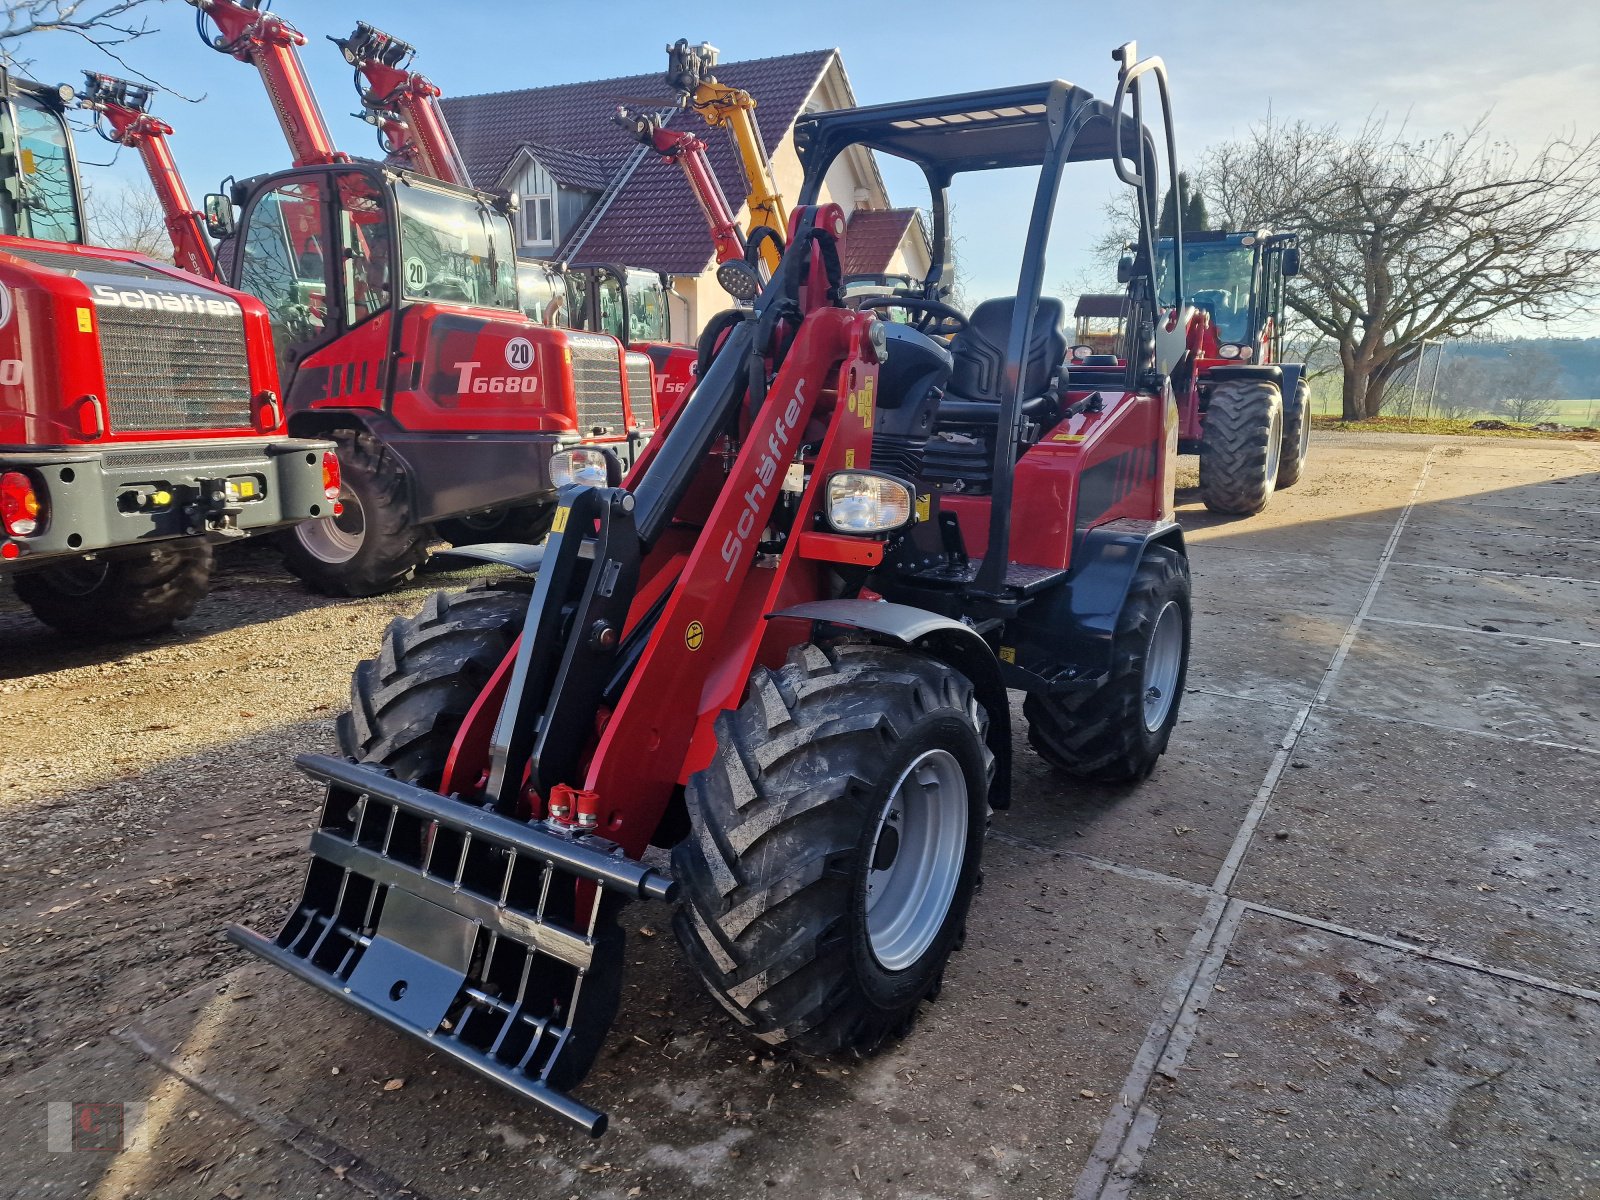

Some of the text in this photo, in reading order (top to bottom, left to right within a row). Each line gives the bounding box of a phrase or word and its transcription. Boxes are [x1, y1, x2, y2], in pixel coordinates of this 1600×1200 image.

[410, 262, 423, 284] 20
[93, 284, 243, 316] Schäffer
[511, 343, 529, 364] 20
[453, 361, 538, 394] T6680
[655, 373, 688, 393] T56
[721, 378, 805, 583] Schäffer
